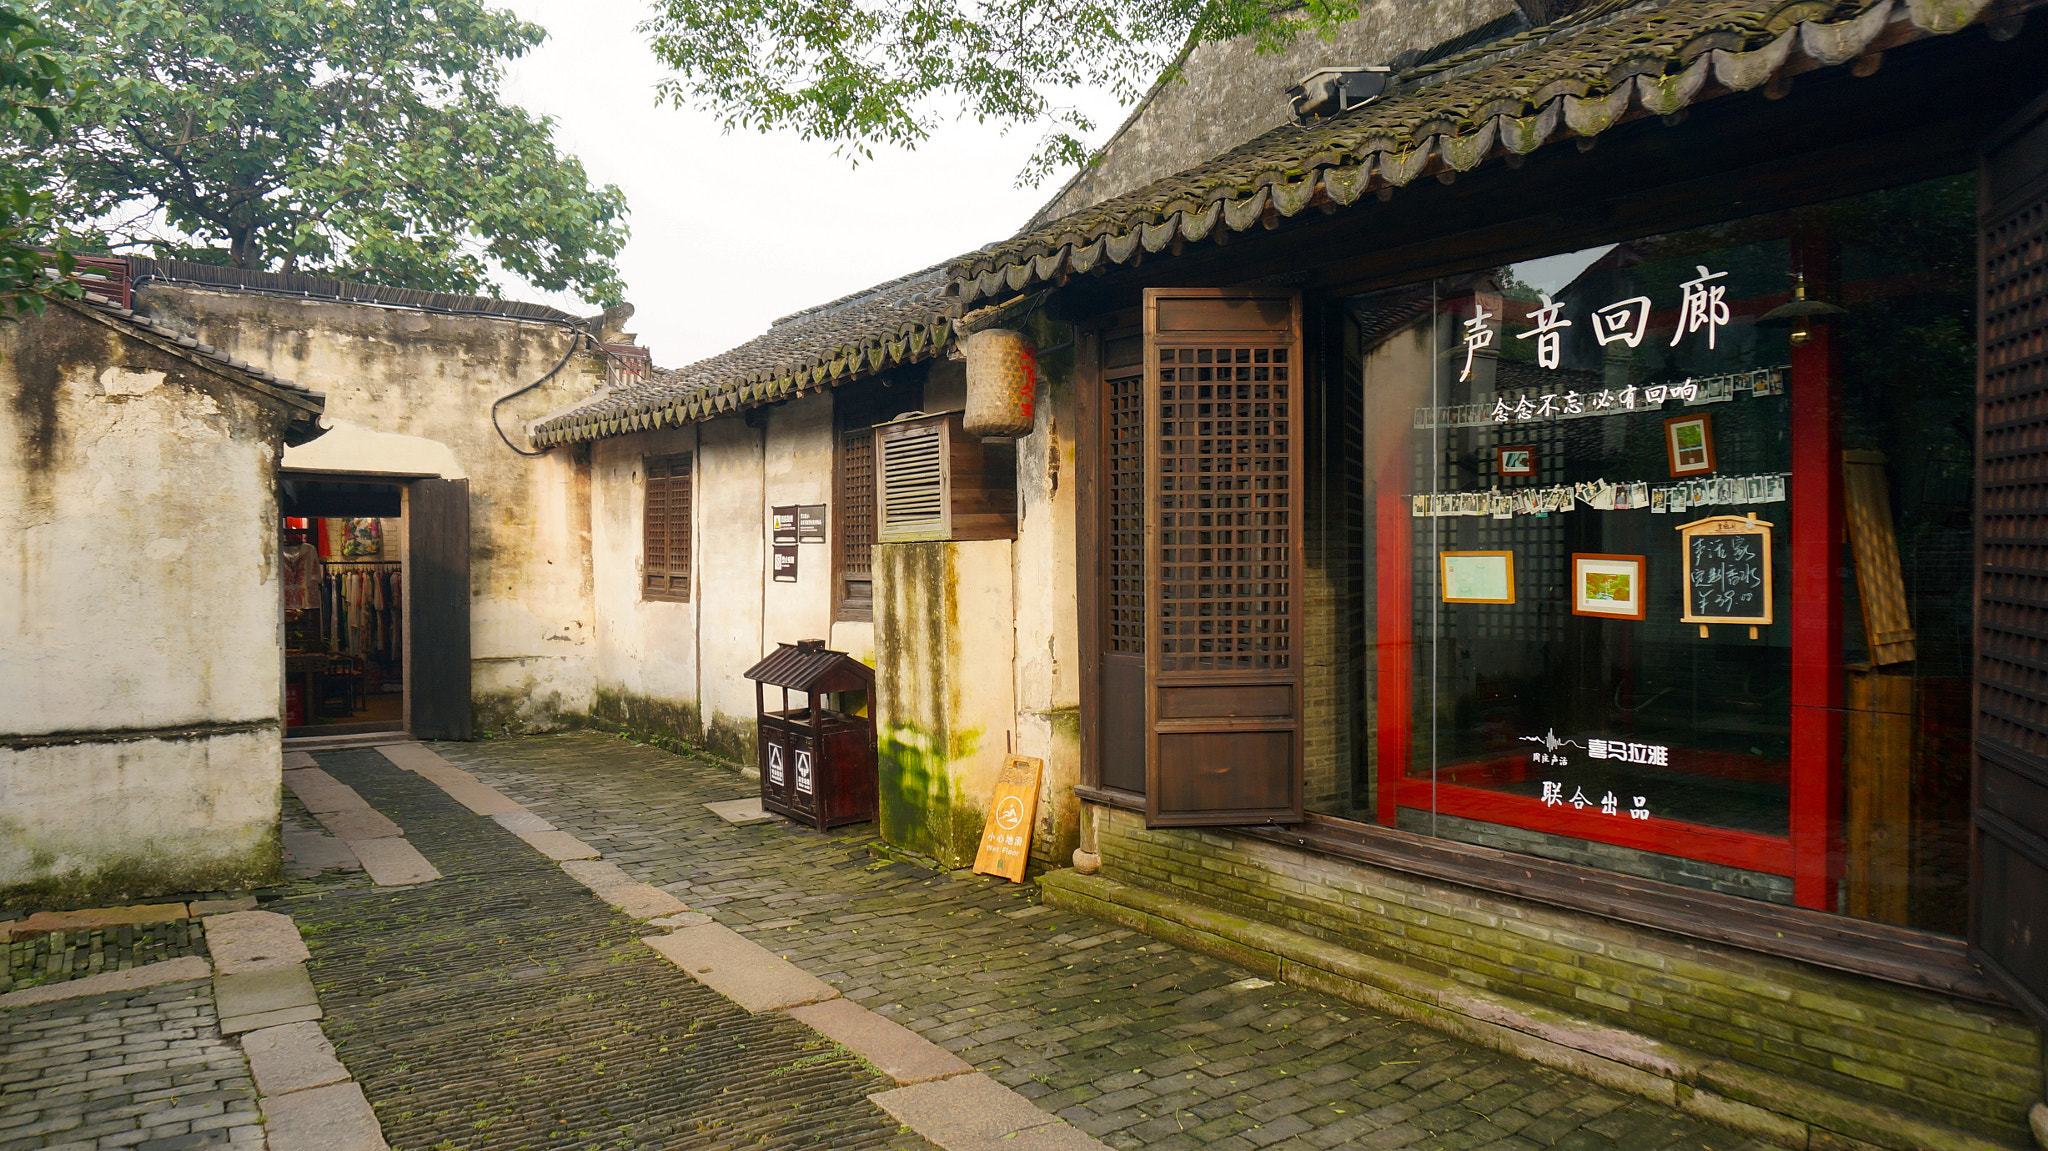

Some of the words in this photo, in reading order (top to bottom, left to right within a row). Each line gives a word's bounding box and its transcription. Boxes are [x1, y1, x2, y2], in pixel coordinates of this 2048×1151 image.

[1459, 265, 1731, 383] 声音回廊
[1588, 738, 1669, 767] 喜马拉雅
[1540, 780, 1650, 820] 联合出品
[986, 844, 999, 853] Wet
[1001, 846, 1020, 856] Floor
[987, 832, 1023, 847] 小心地滑
